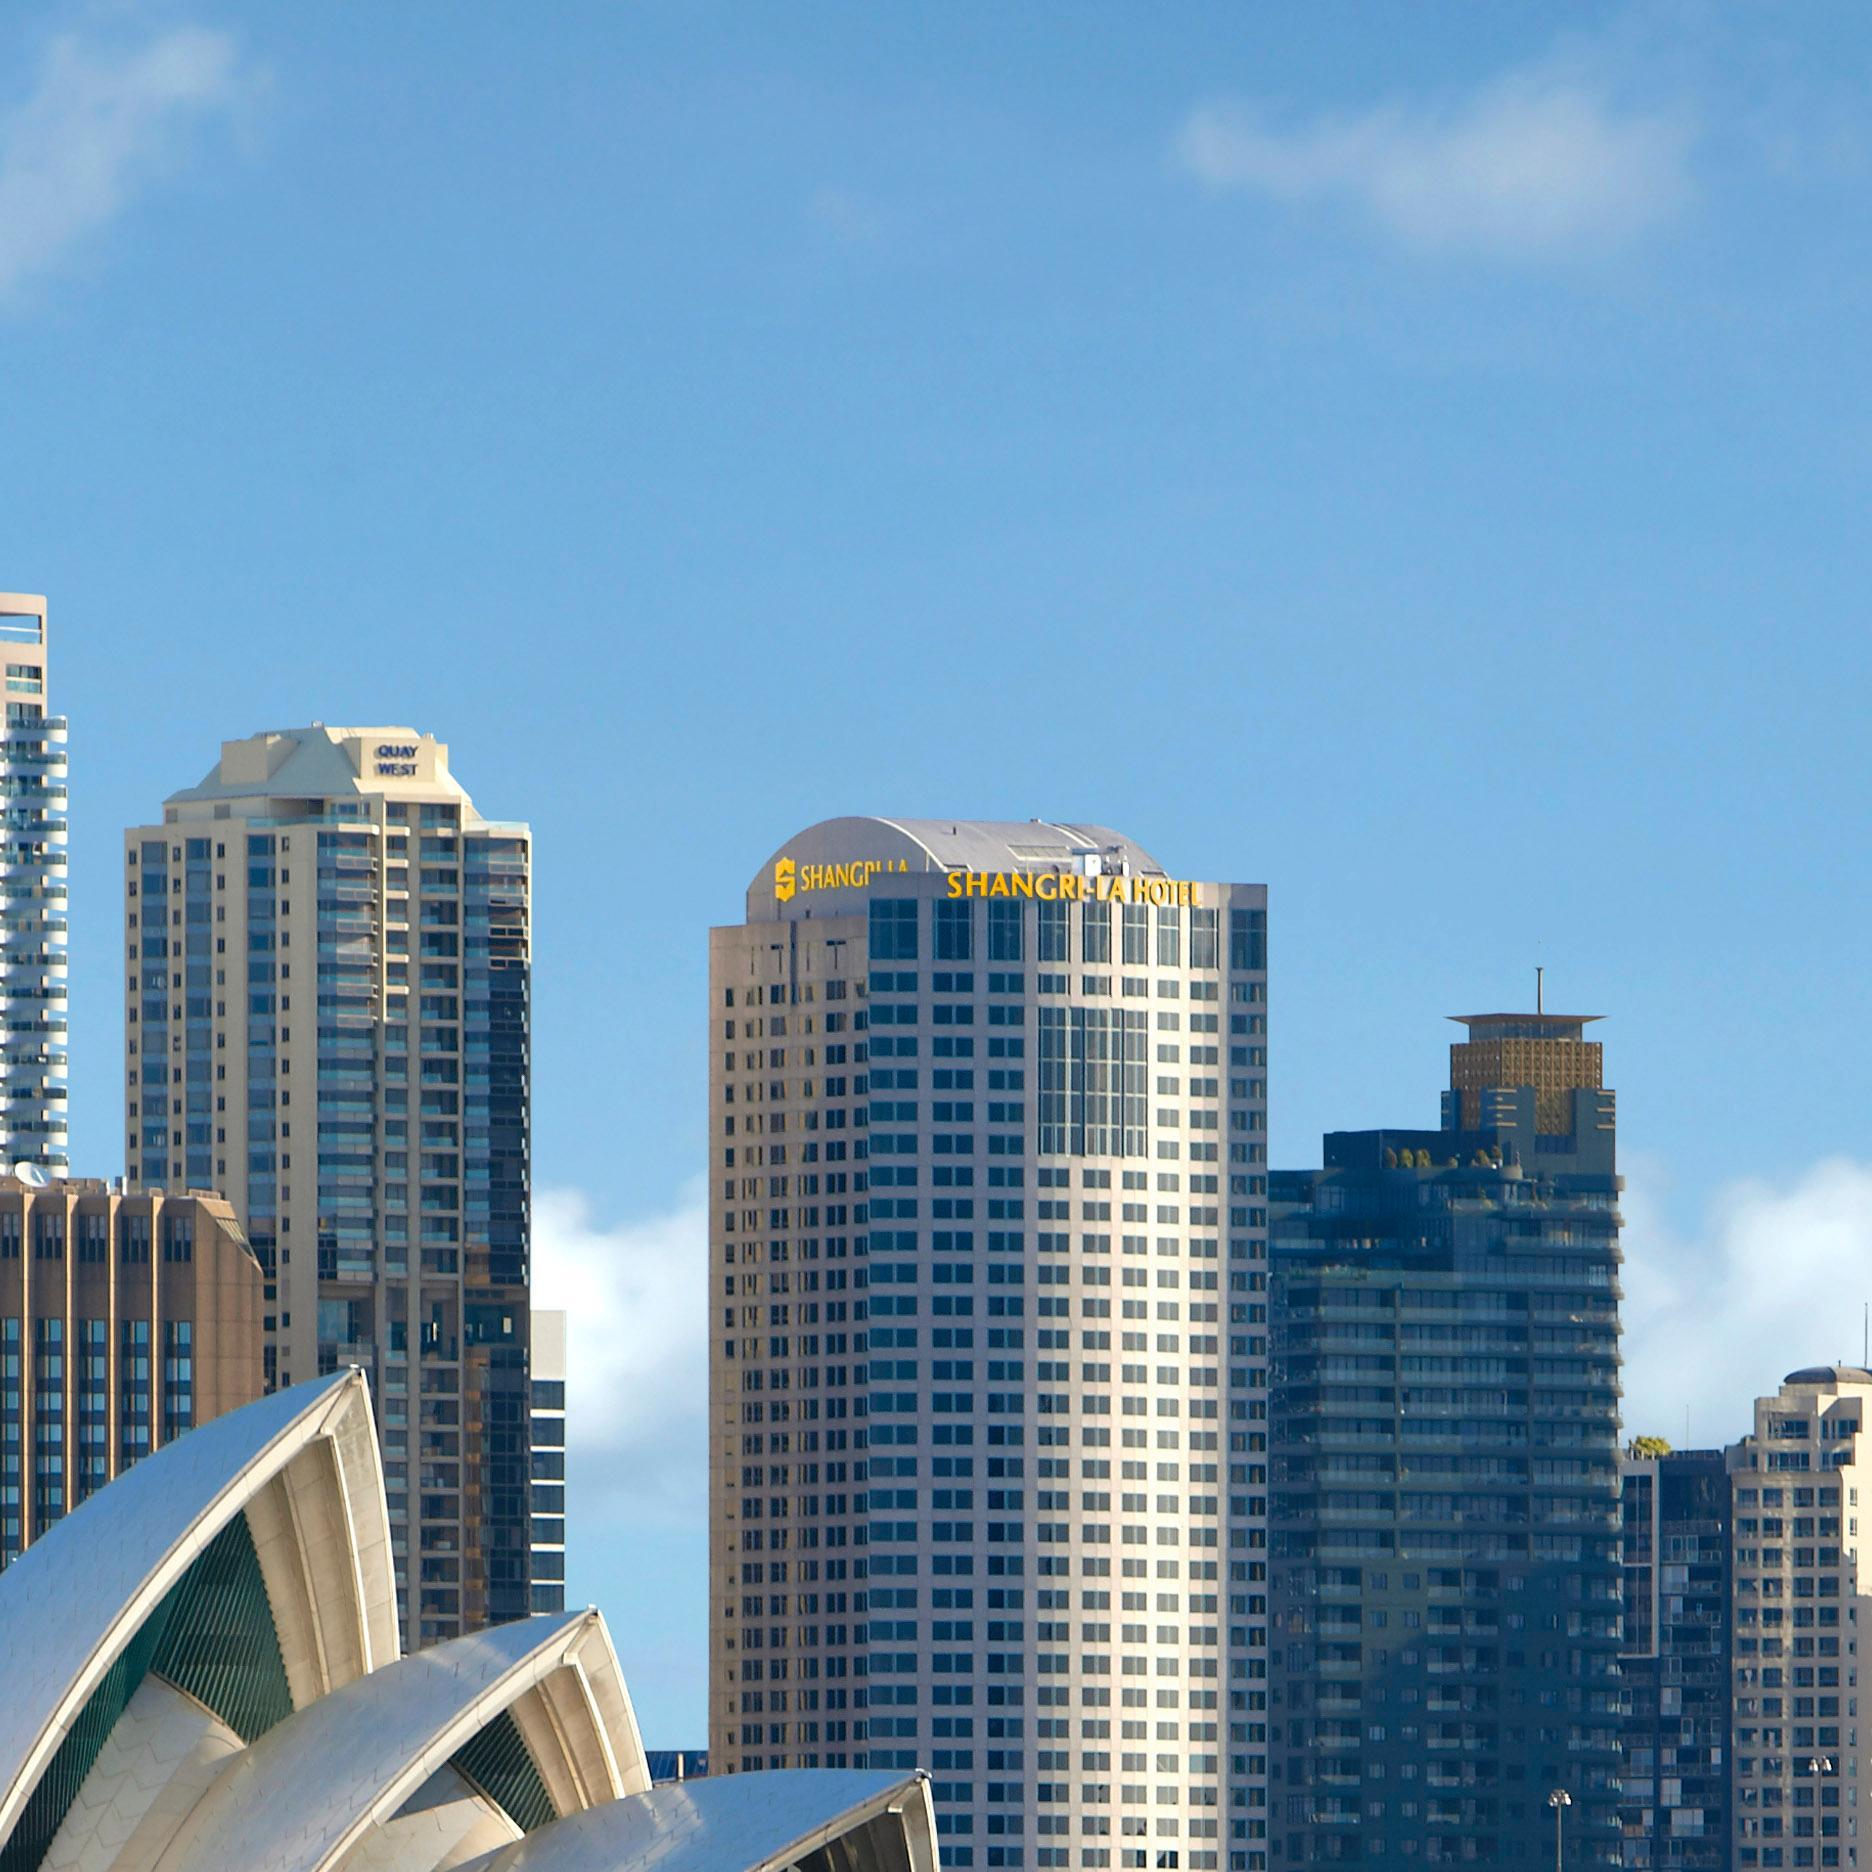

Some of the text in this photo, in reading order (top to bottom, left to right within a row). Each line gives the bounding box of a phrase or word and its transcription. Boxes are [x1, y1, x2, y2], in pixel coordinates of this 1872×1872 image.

[378, 744, 419, 758] QUAY
[378, 763, 418, 776] WEST
[947, 871, 1201, 907] SHANGRI-LA HOTEL
